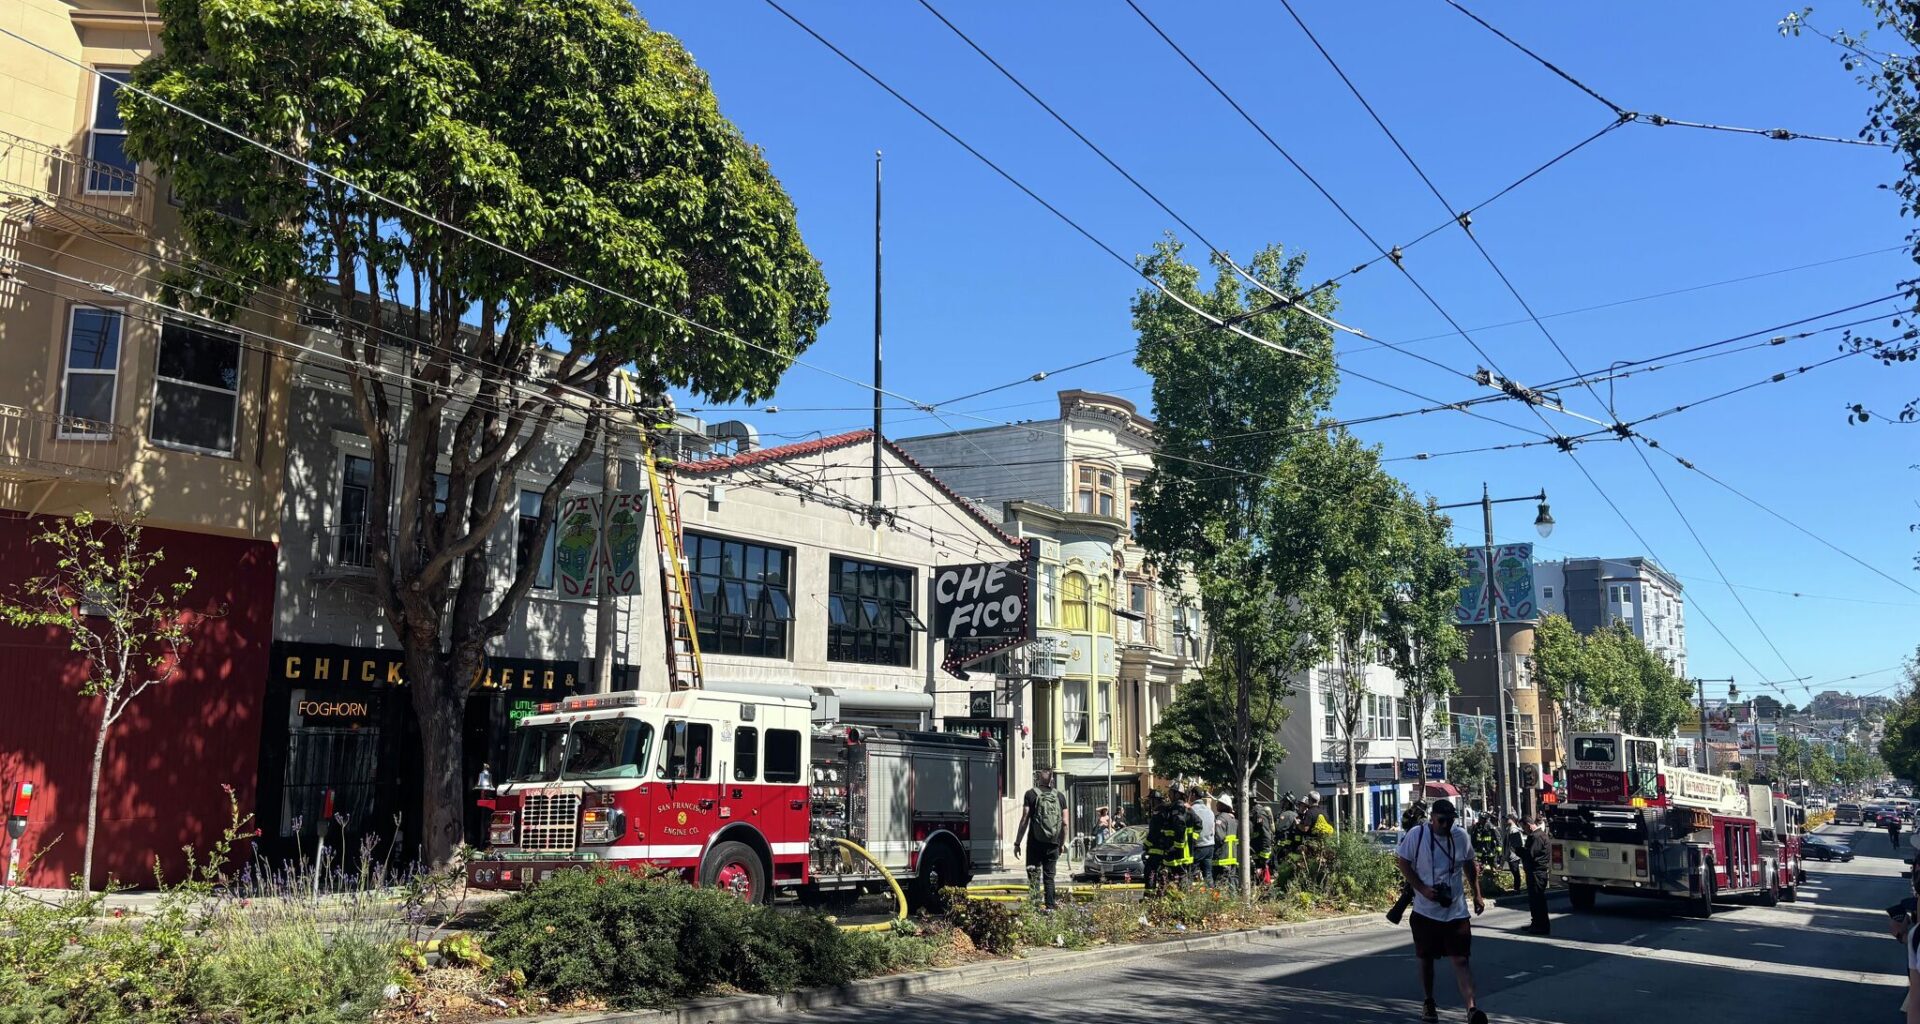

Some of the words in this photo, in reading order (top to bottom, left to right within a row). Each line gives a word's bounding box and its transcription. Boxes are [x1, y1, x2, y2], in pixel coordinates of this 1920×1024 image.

[562, 570, 635, 597] DERO
[936, 562, 1010, 604] CHE
[565, 673, 575, 687] &
[298, 701, 368, 716] FOGHORN
[1590, 779, 1603, 787] T5
[601, 793, 616, 804] E5
[657, 802, 671, 813] SAN
[663, 826, 687, 836] ENGINE
